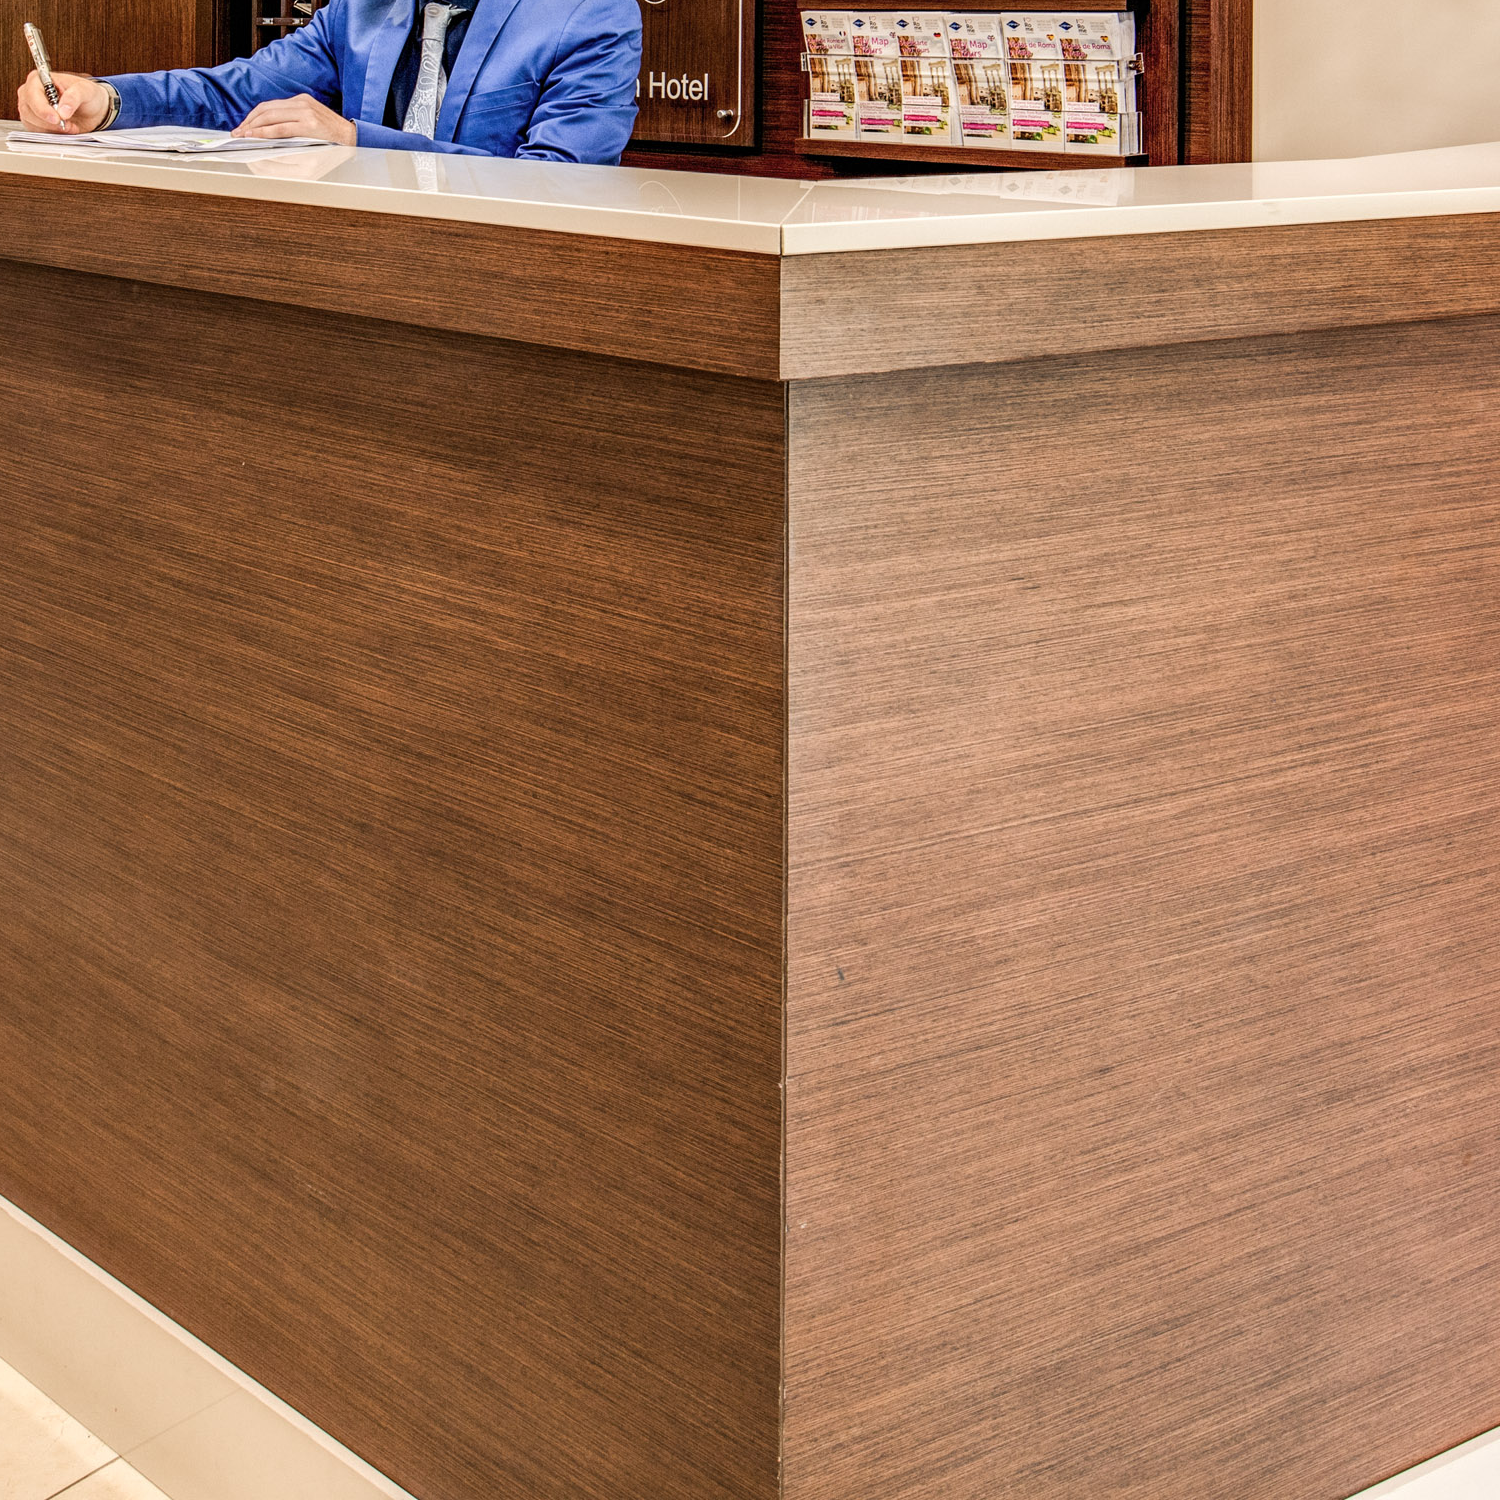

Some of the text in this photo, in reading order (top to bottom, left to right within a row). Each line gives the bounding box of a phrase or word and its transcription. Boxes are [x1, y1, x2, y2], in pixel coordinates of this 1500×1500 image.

[872, 37, 889, 46] Map
[970, 40, 988, 49] Map
[649, 72, 708, 100] Hotel
